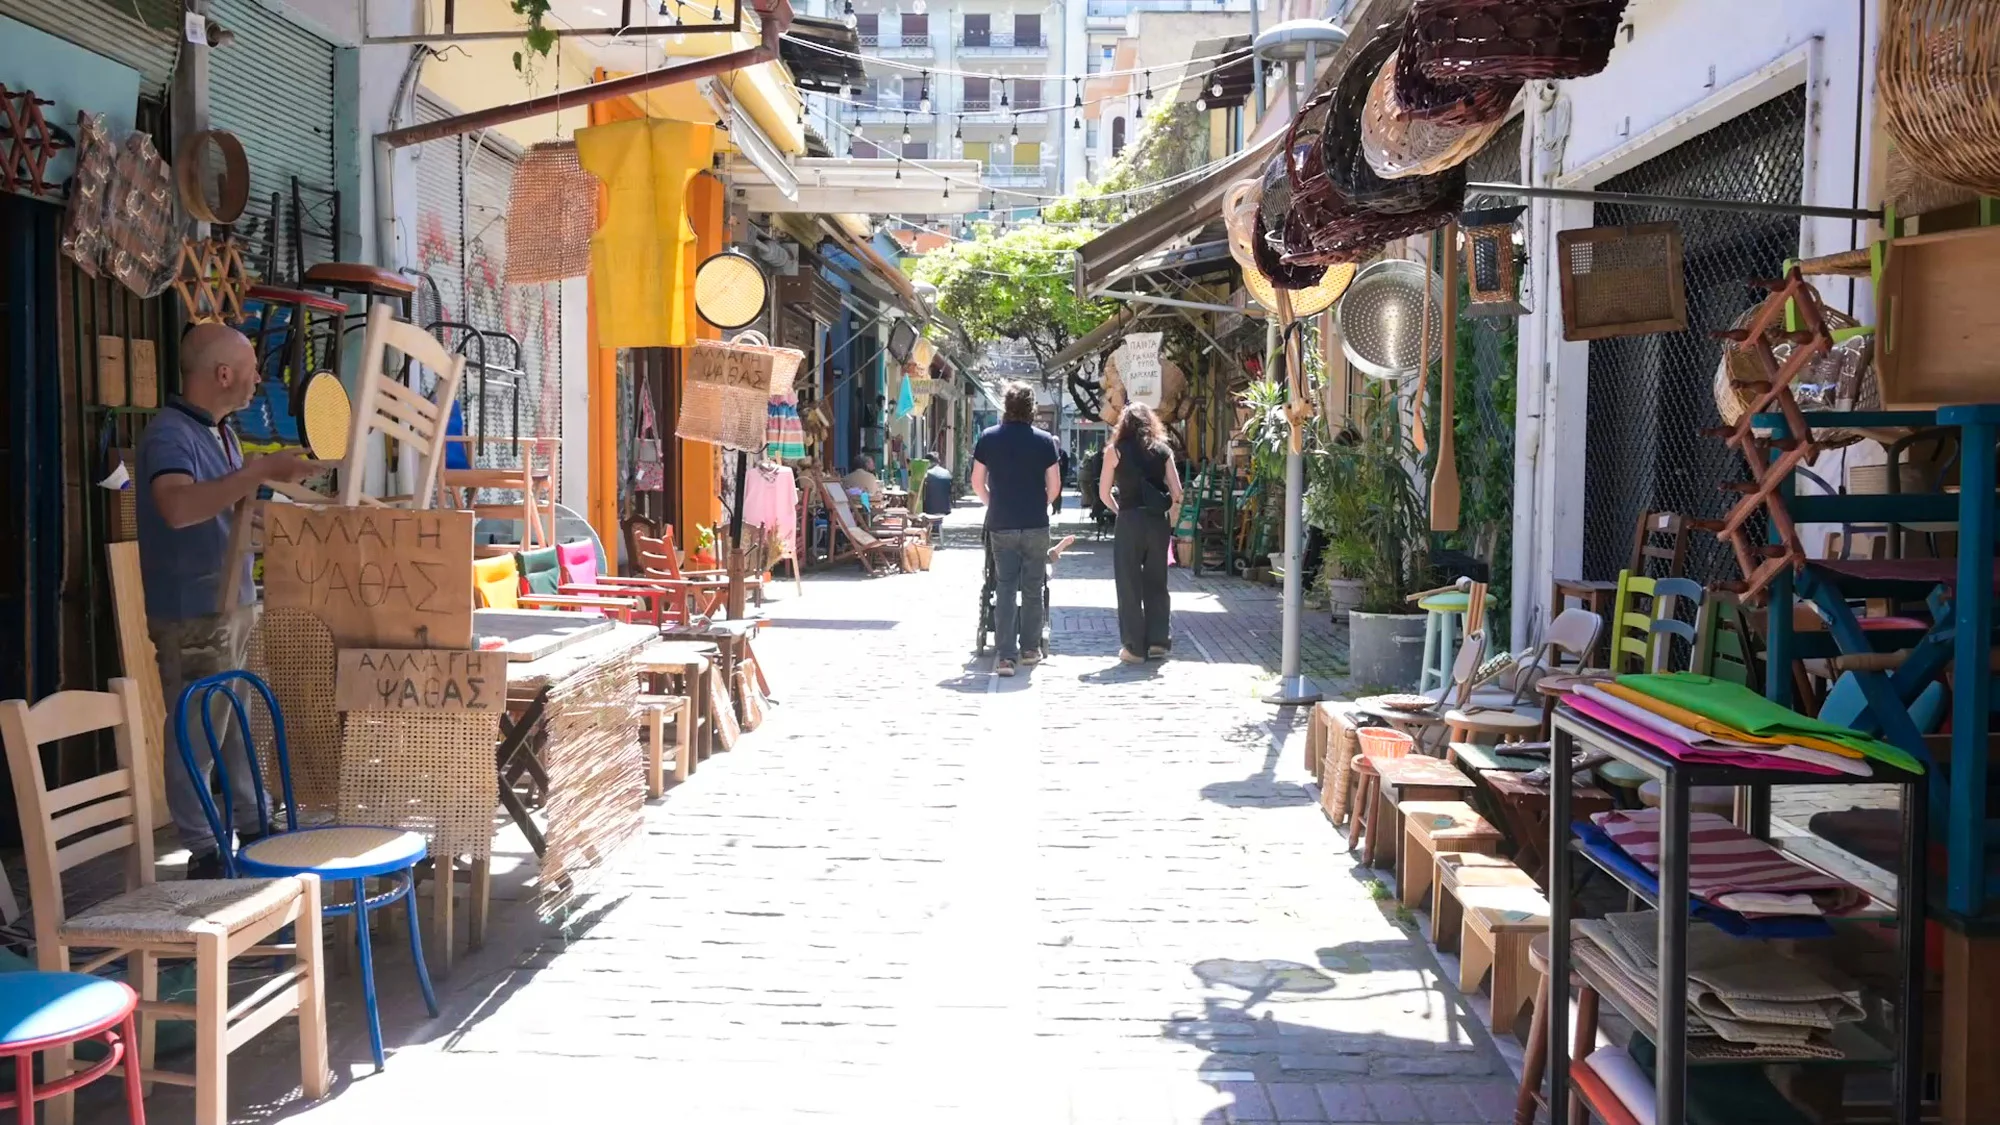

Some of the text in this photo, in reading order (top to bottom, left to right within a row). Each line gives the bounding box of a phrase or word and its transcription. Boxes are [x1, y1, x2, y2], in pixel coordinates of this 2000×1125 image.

[695, 348, 761, 364] ΑΛΛΑΓΗ
[703, 366, 766, 390] ΨΑΘΑΣ
[267, 515, 442, 550] ΑΛΛΑΓΗ
[295, 559, 453, 615] ΨΑΘΑΣ
[358, 651, 482, 673] ΑΛΛΑΓΗ
[376, 677, 488, 709] ΨΑΘΑΣ
